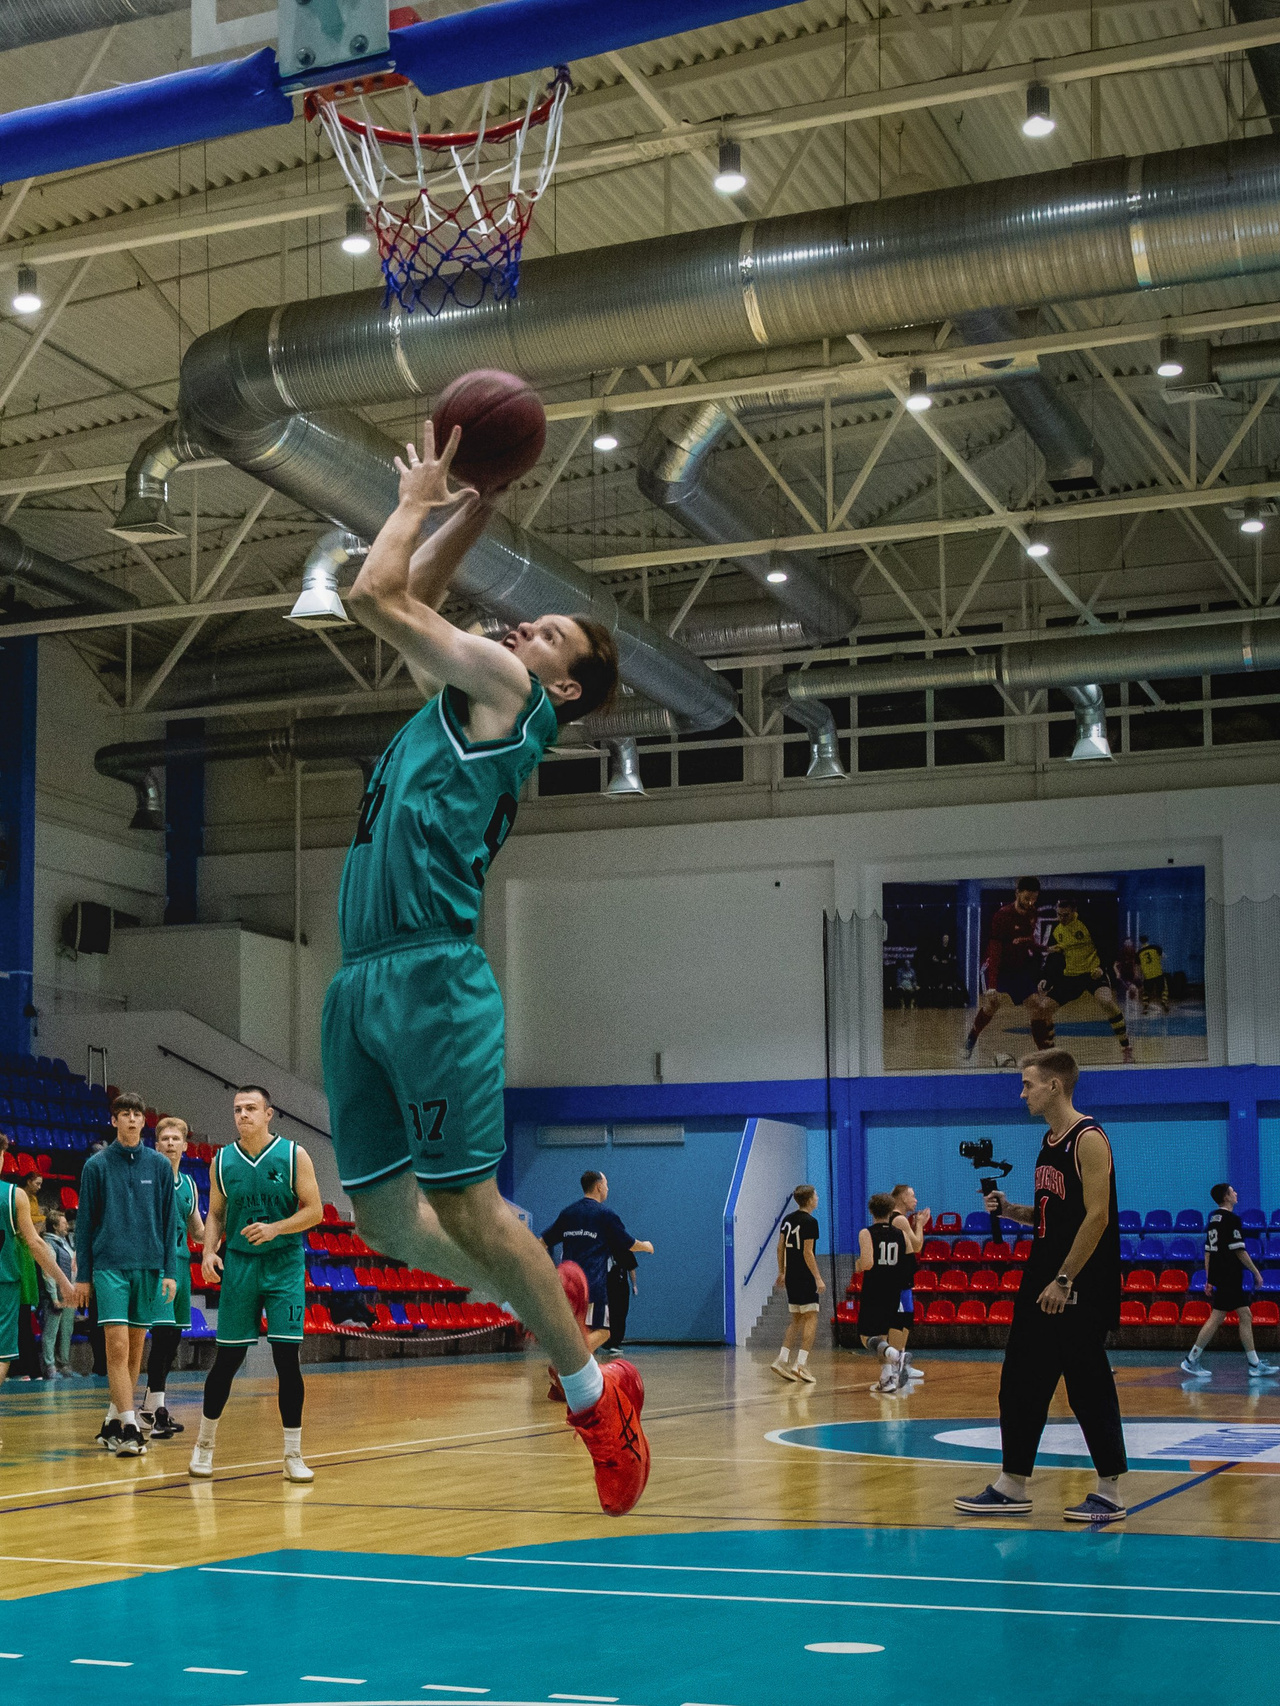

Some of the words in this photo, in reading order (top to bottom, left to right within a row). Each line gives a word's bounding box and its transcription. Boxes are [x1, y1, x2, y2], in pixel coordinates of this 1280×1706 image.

[781, 1221, 801, 1250] 21
[878, 1241, 899, 1266] 10
[288, 1304, 303, 1322] 17
